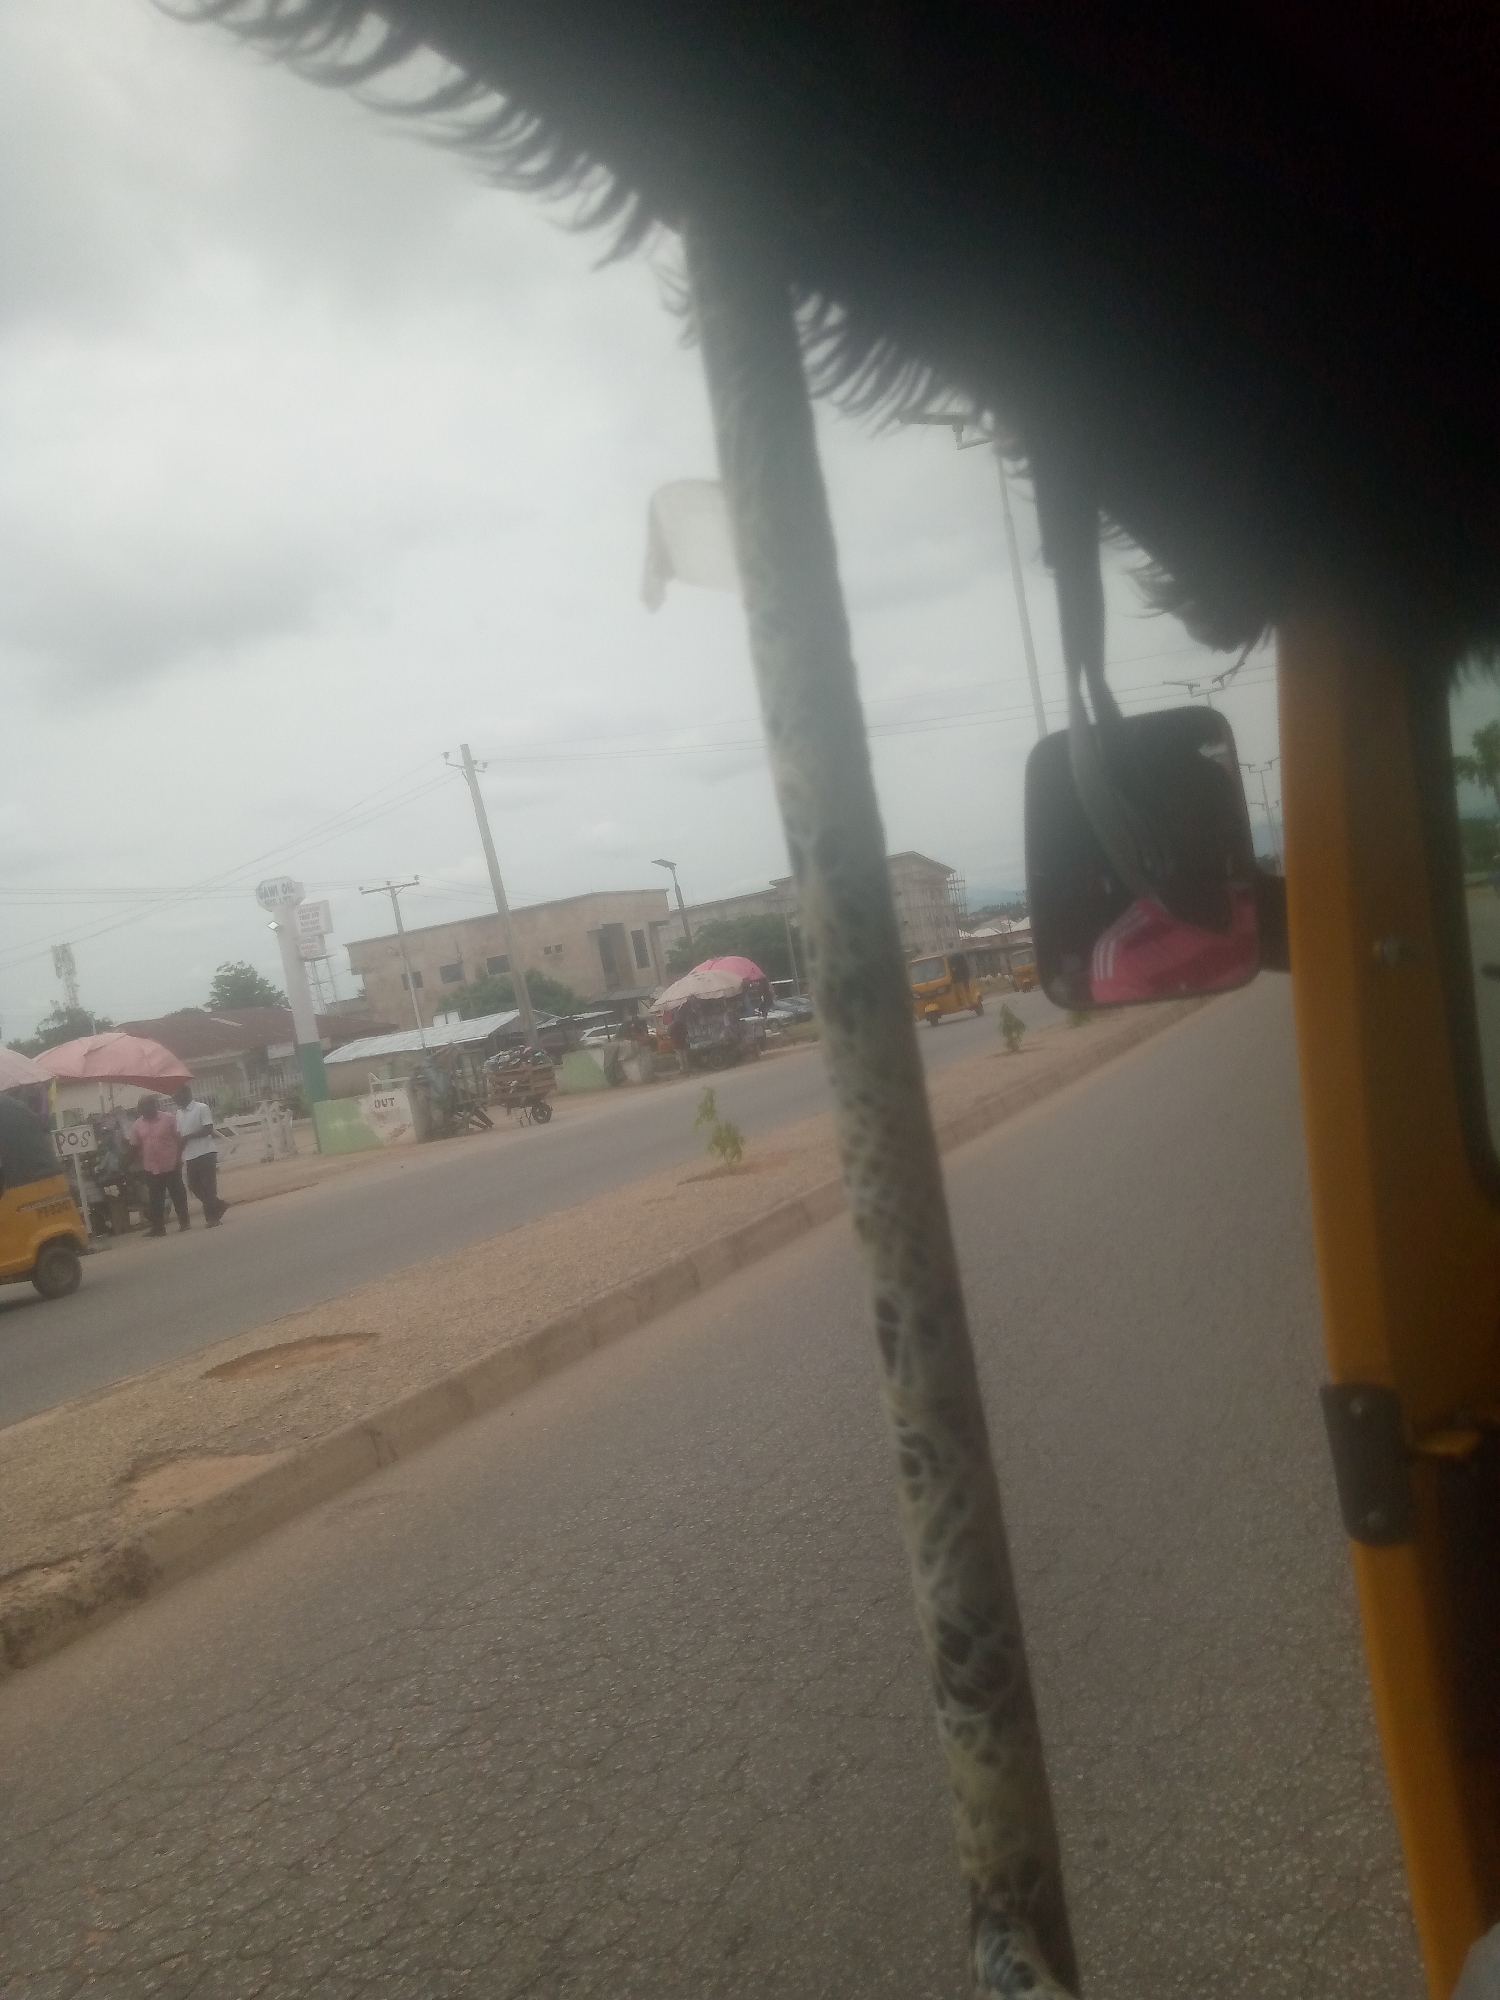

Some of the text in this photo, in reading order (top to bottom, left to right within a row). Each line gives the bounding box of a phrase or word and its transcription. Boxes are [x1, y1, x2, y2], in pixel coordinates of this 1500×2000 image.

[281, 882, 295, 895] OIL
[374, 1097, 395, 1108] OUT
[55, 1130, 91, 1155] POS
